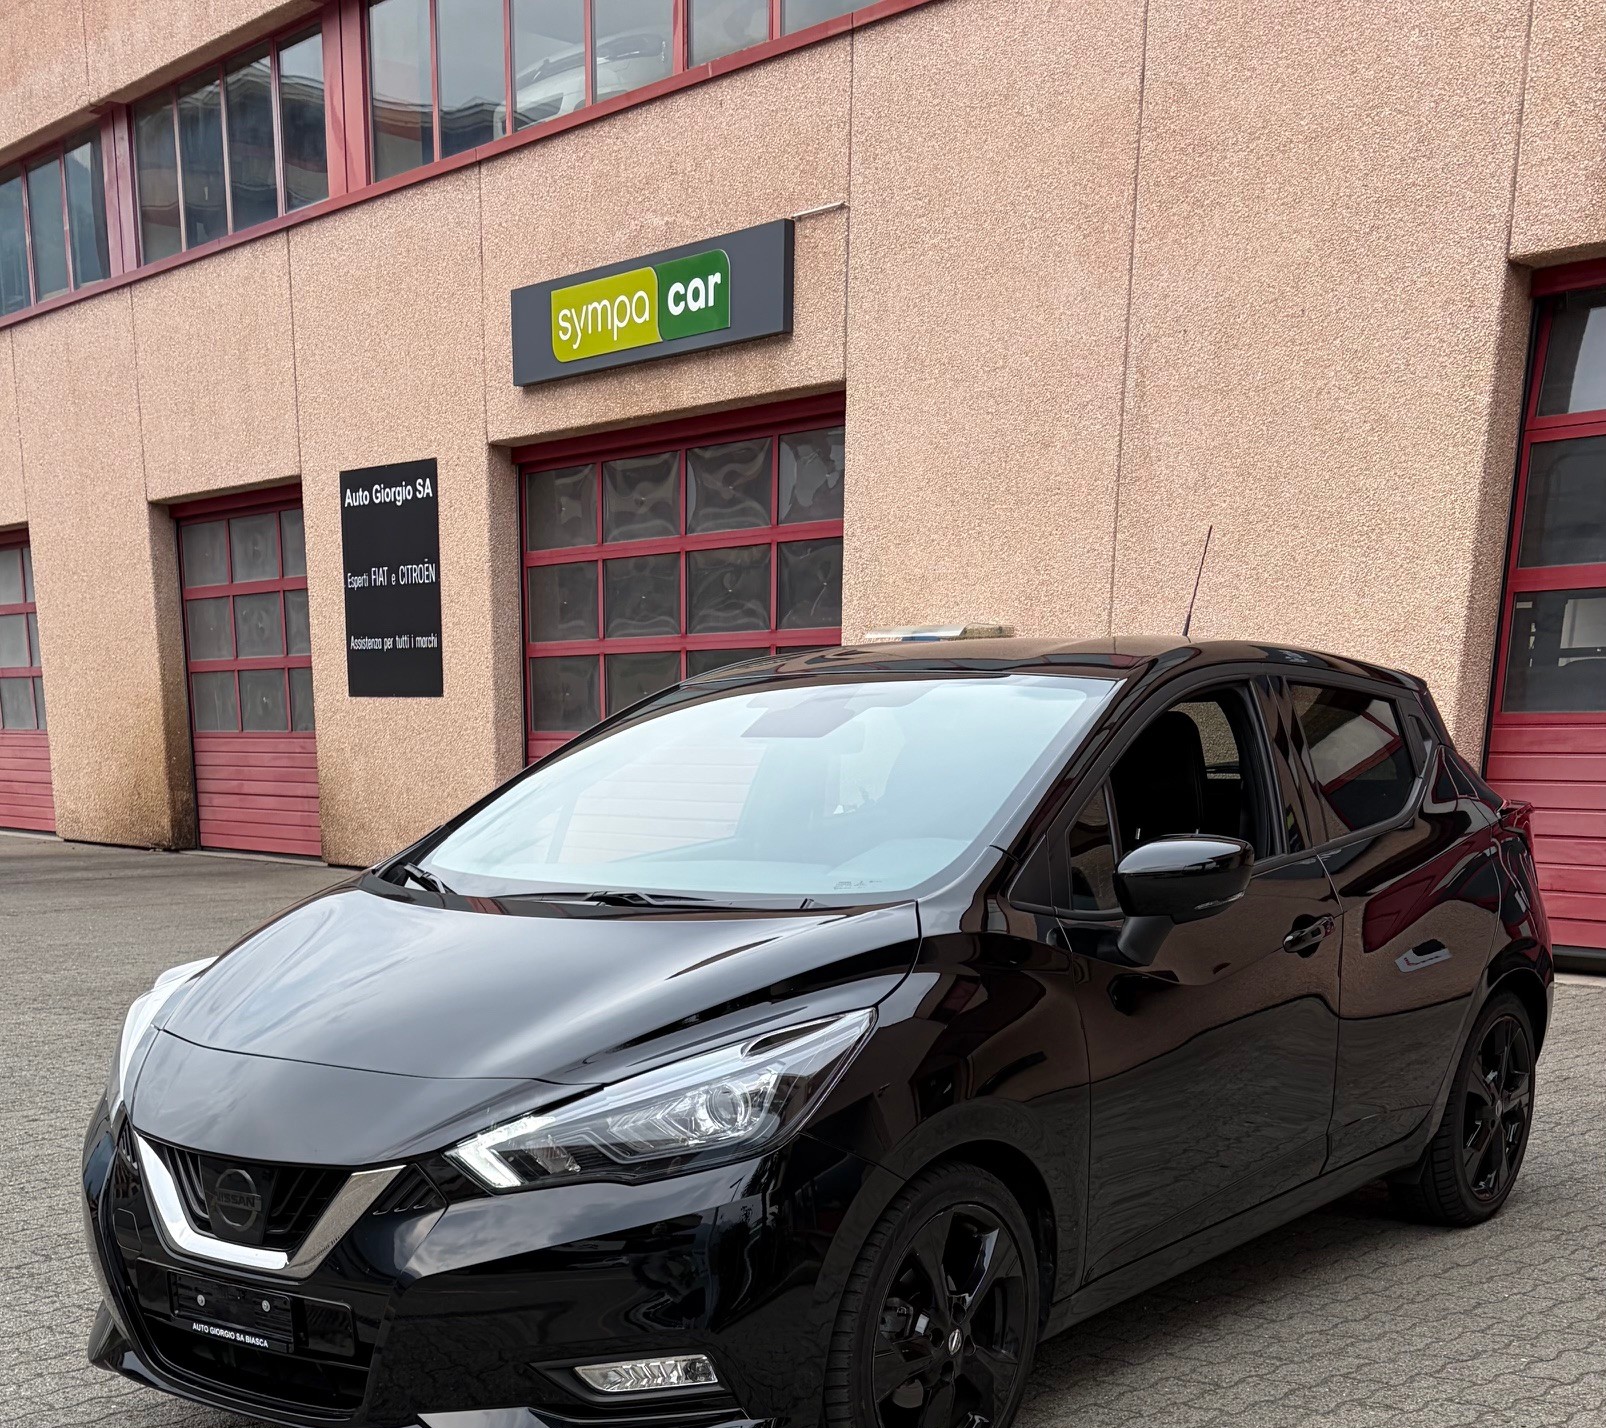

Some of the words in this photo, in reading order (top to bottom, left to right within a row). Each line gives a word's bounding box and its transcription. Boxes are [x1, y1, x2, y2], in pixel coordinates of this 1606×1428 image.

[558, 290, 650, 349] sympa
[667, 271, 722, 316] car
[344, 488, 370, 508] Auto
[372, 481, 413, 506] Giorgio
[416, 477, 433, 499] SA
[347, 572, 369, 591] Esperti
[371, 566, 388, 587] FIAT
[391, 573, 396, 586] e
[399, 558, 436, 585] CITROËN
[350, 635, 382, 650] Assistenza
[383, 637, 394, 652] per
[395, 634, 410, 649] tutti
[411, 634, 414, 649] i
[415, 632, 438, 649] marchi
[192, 1322, 209, 1333] AUTO
[209, 1326, 235, 1340] GIORGIO
[235, 1332, 245, 1343] SA
[245, 1335, 269, 1348] BIASCA
